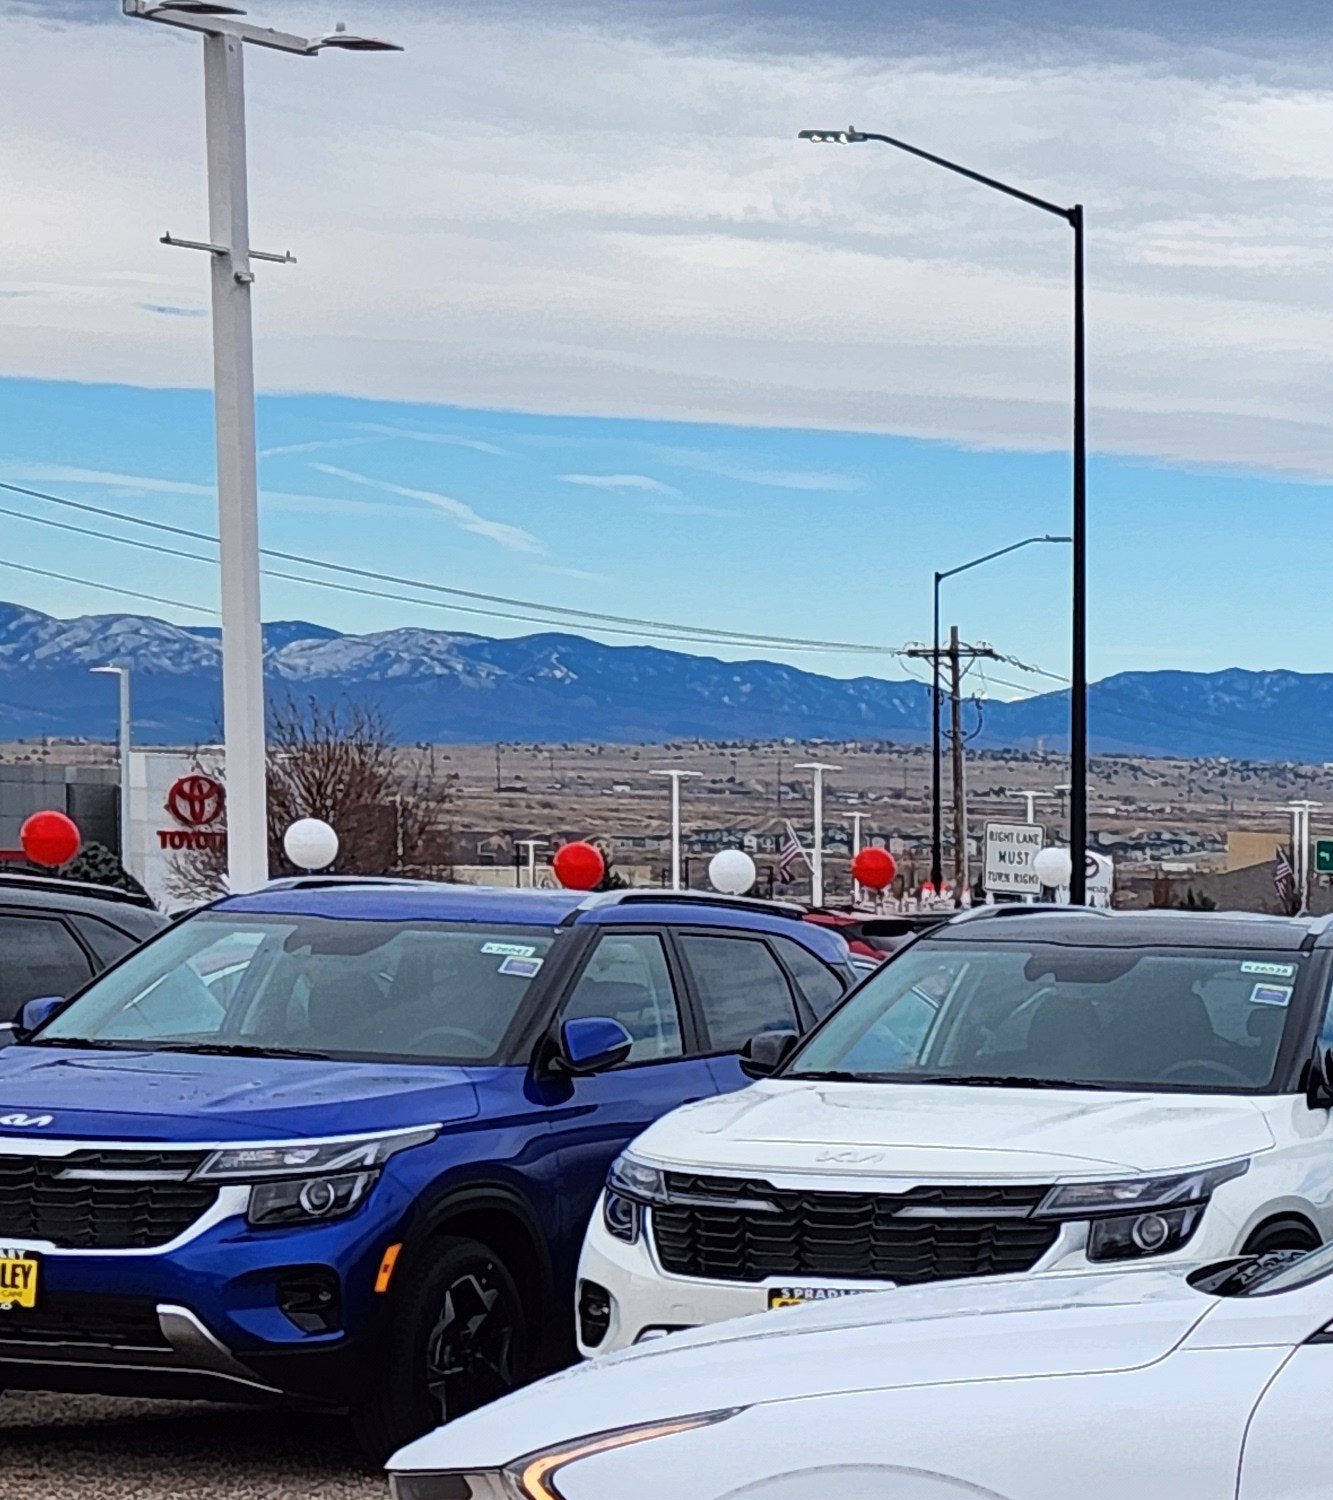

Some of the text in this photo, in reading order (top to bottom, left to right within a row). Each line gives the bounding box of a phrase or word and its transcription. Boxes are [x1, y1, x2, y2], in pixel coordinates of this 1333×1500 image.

[157, 831, 227, 851] TOYOT
[989, 830, 1040, 845] RIGHT LANE
[999, 851, 1031, 866] MUST
[987, 870, 1040, 885] TURN RIGHT
[780, 1288, 860, 1300] SPRADL
